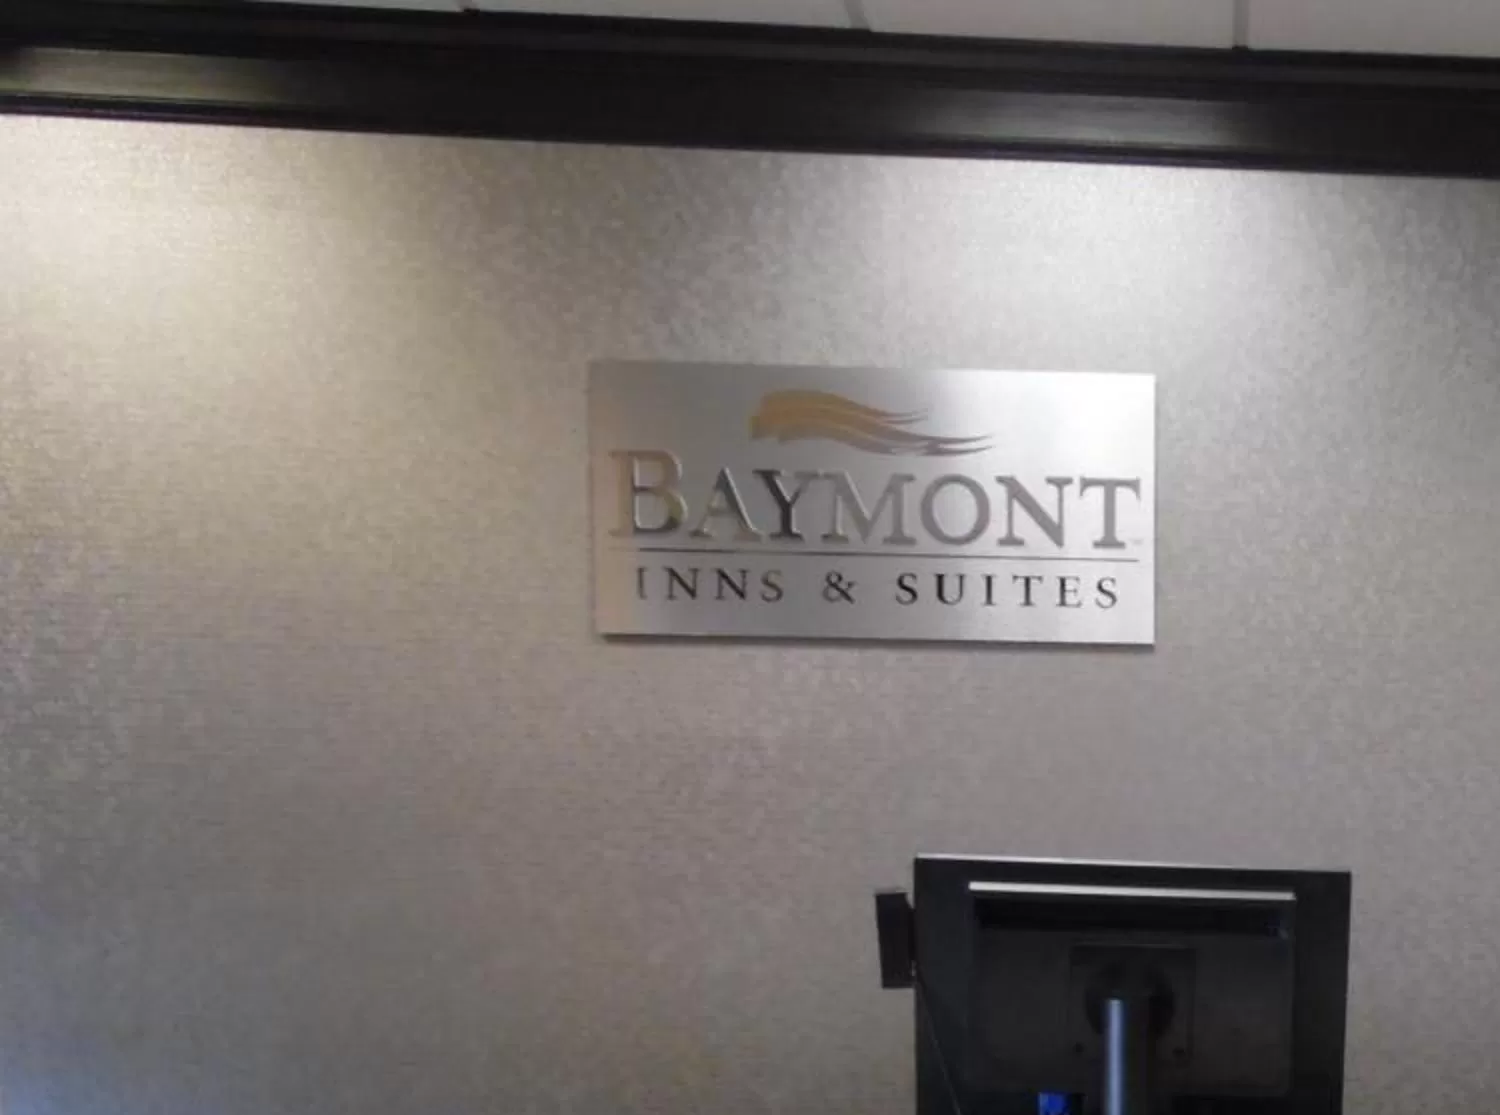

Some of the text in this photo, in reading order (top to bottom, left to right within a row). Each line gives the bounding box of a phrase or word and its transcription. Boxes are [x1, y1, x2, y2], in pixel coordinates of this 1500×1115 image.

[608, 449, 1142, 550] BAYMONT
[635, 566, 1118, 608] INNS & SUITES
